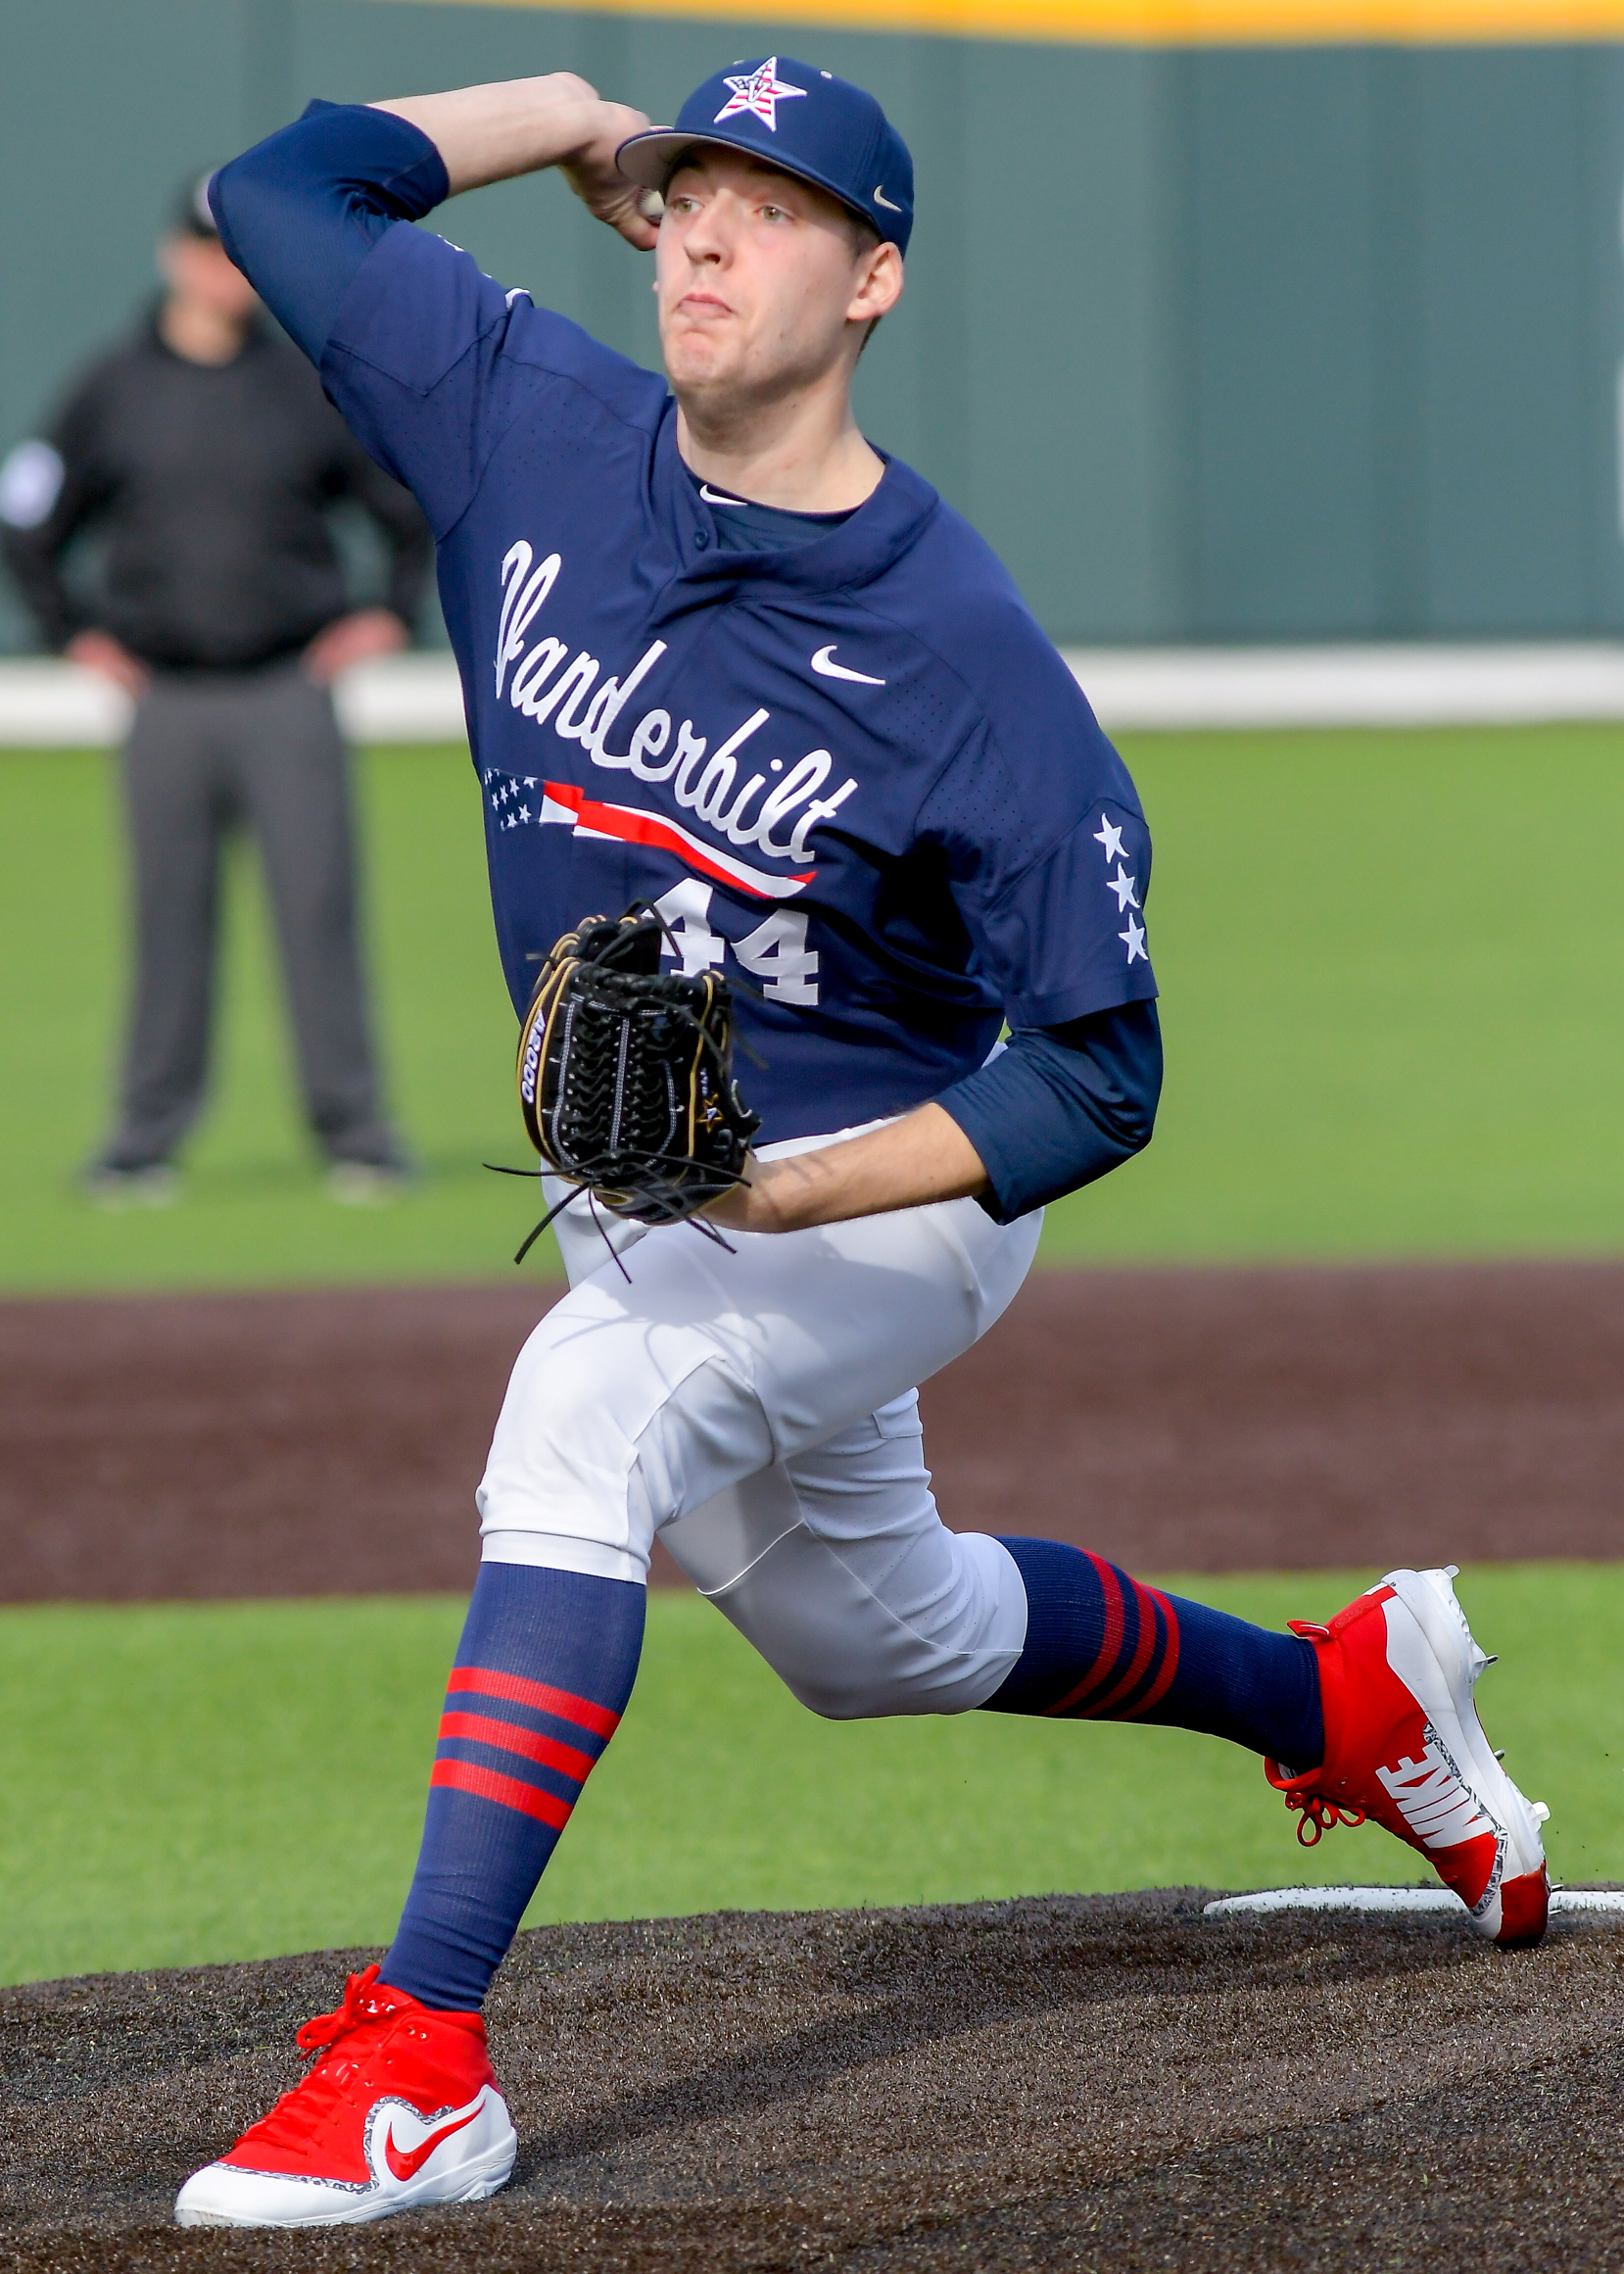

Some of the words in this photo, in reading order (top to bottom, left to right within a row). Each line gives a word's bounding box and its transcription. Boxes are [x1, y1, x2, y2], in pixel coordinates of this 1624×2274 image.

[747, 78, 772, 103] V
[495, 540, 858, 863] Vanderbilt
[639, 877, 819, 1006] 44
[521, 1009, 546, 1104] A2000
[1374, 1743, 1497, 1849] NIKE
